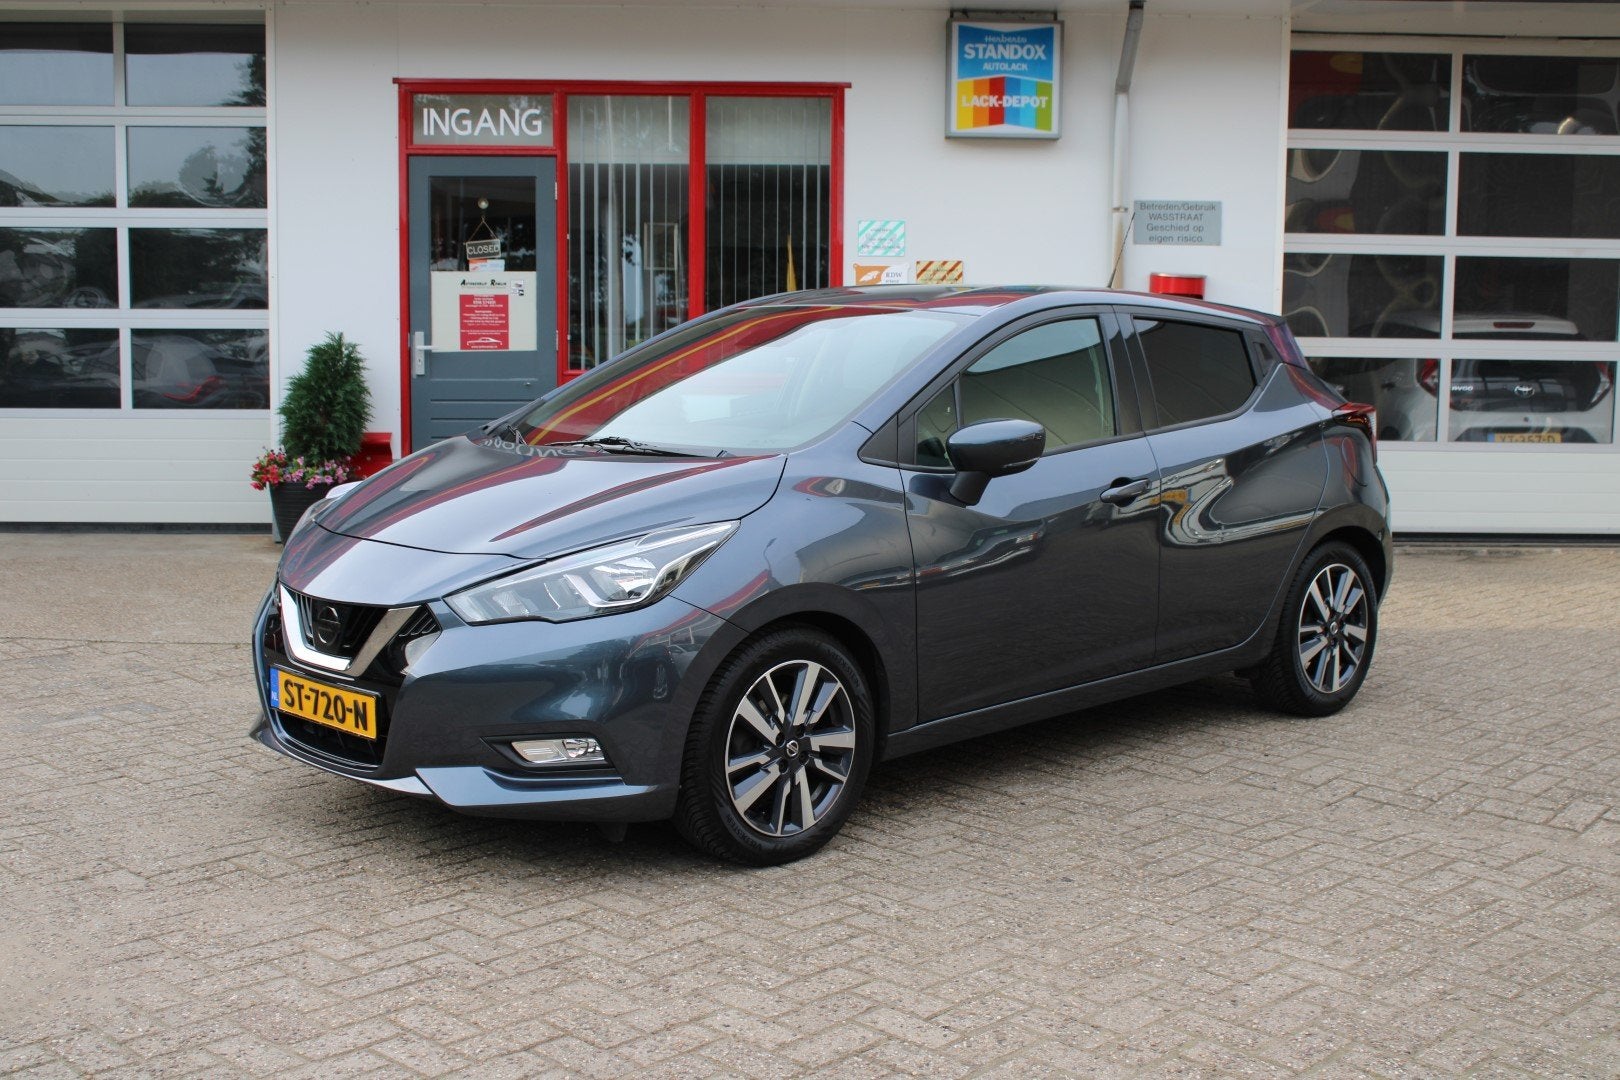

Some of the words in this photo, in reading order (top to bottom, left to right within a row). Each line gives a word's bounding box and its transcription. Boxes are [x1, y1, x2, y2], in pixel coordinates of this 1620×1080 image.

[964, 43, 1047, 60] STANDOX
[982, 62, 1028, 71] AUTOLACK
[961, 95, 1048, 108] LACK-DEPOT
[422, 107, 543, 136] INGANG
[1140, 202, 1216, 211] Betreden/Gebruik
[1148, 213, 1204, 221] WASSTRAAT
[1146, 223, 1190, 232] Geschied
[1193, 225, 1204, 233] op
[1148, 234, 1174, 243] eigen
[1177, 234, 1203, 243] risico
[467, 244, 499, 255] CLOSED
[284, 678, 368, 732] ST-720-N
